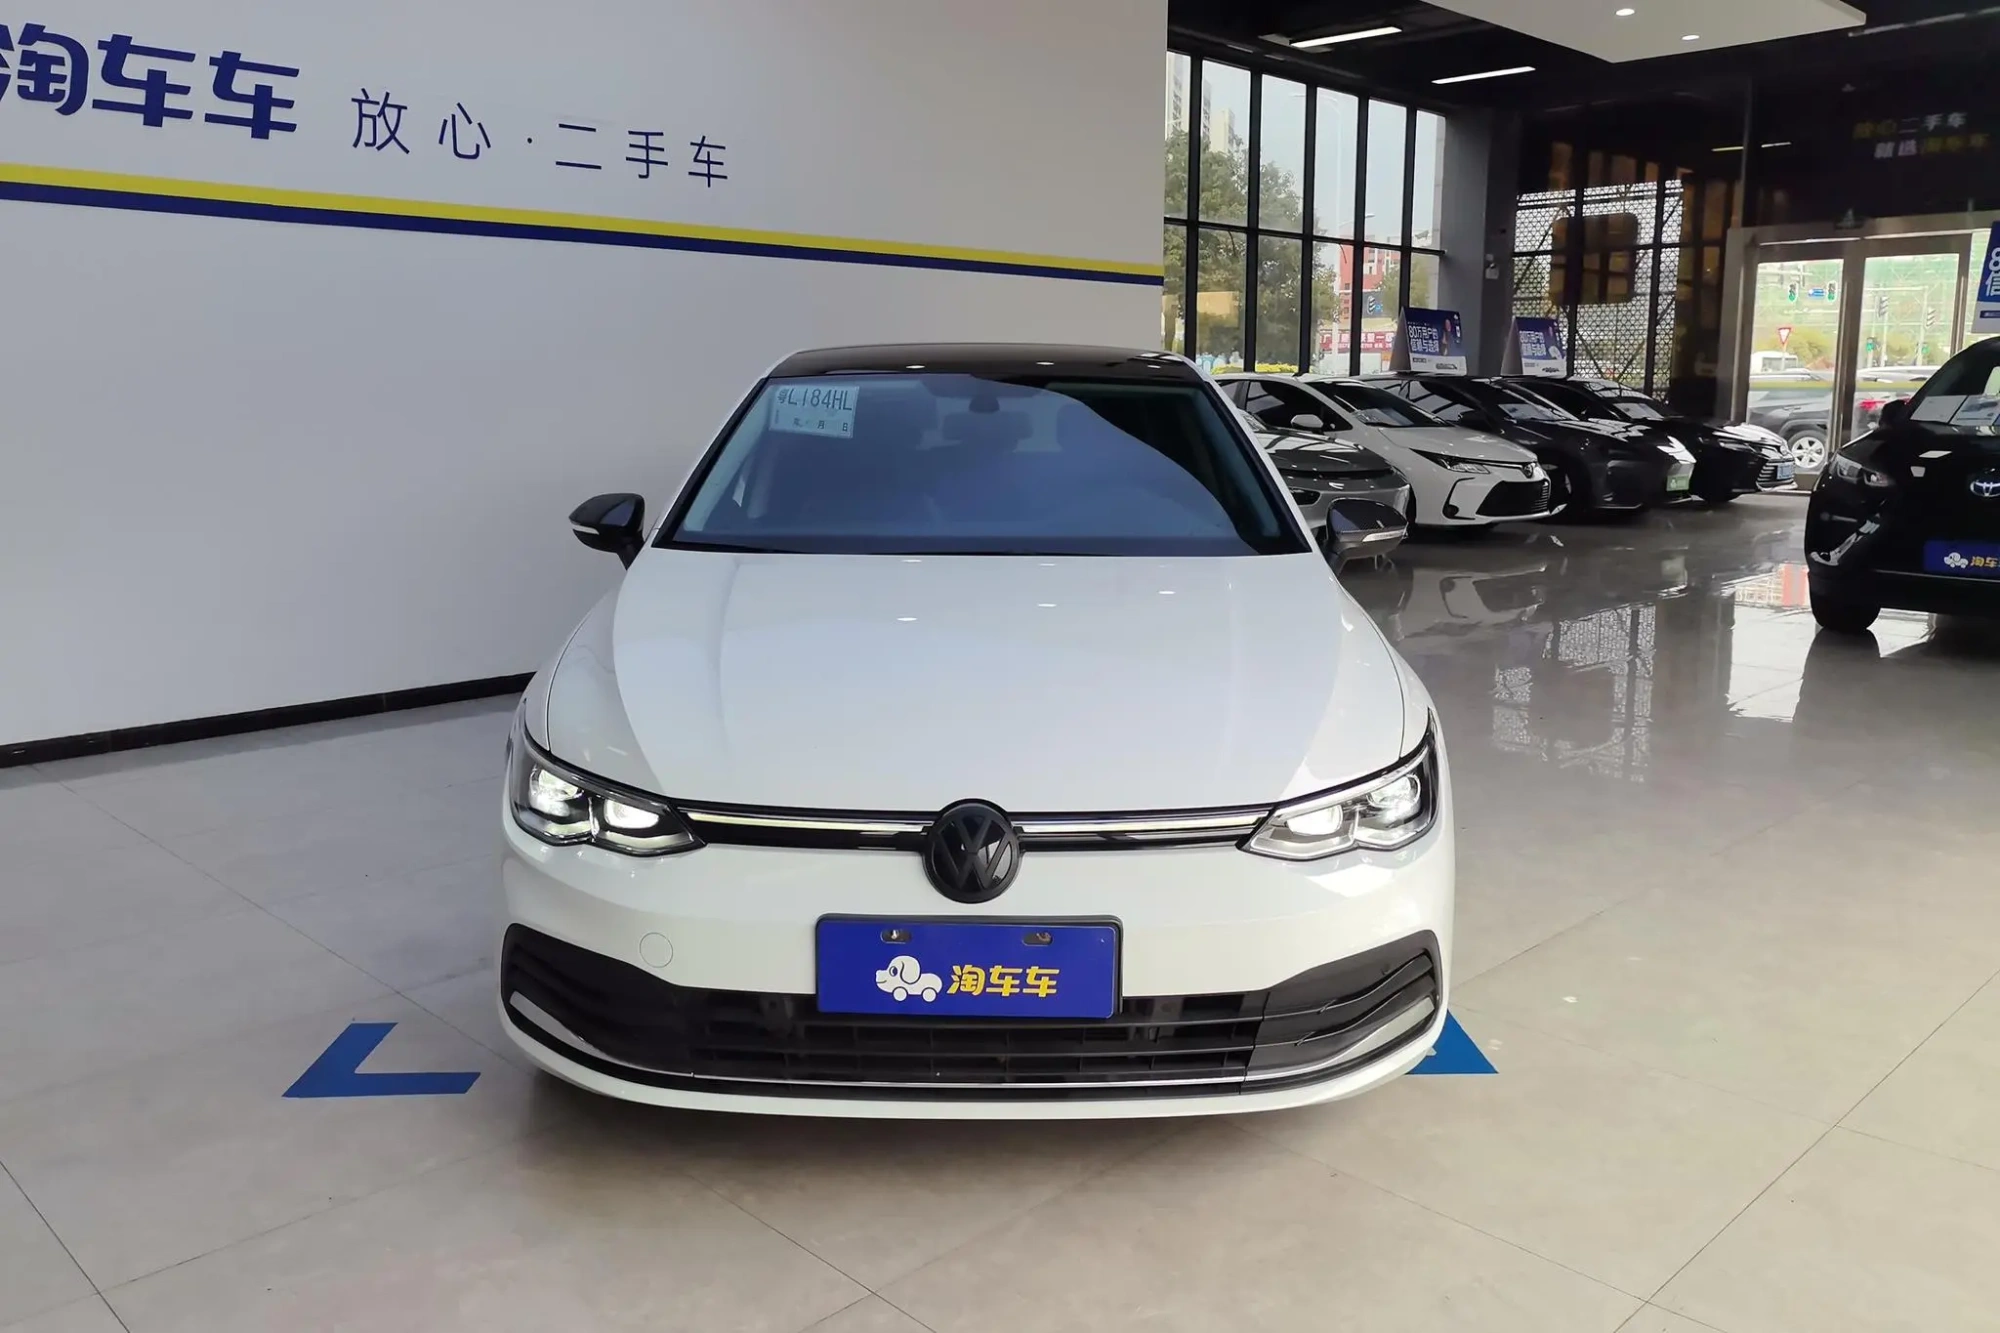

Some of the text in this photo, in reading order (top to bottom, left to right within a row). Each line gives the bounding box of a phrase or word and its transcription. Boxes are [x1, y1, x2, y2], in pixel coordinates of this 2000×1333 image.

[0, 23, 300, 140] 淘车车
[1970, 555, 2000, 569] 淘车
[947, 963, 1061, 999] 淘车车
